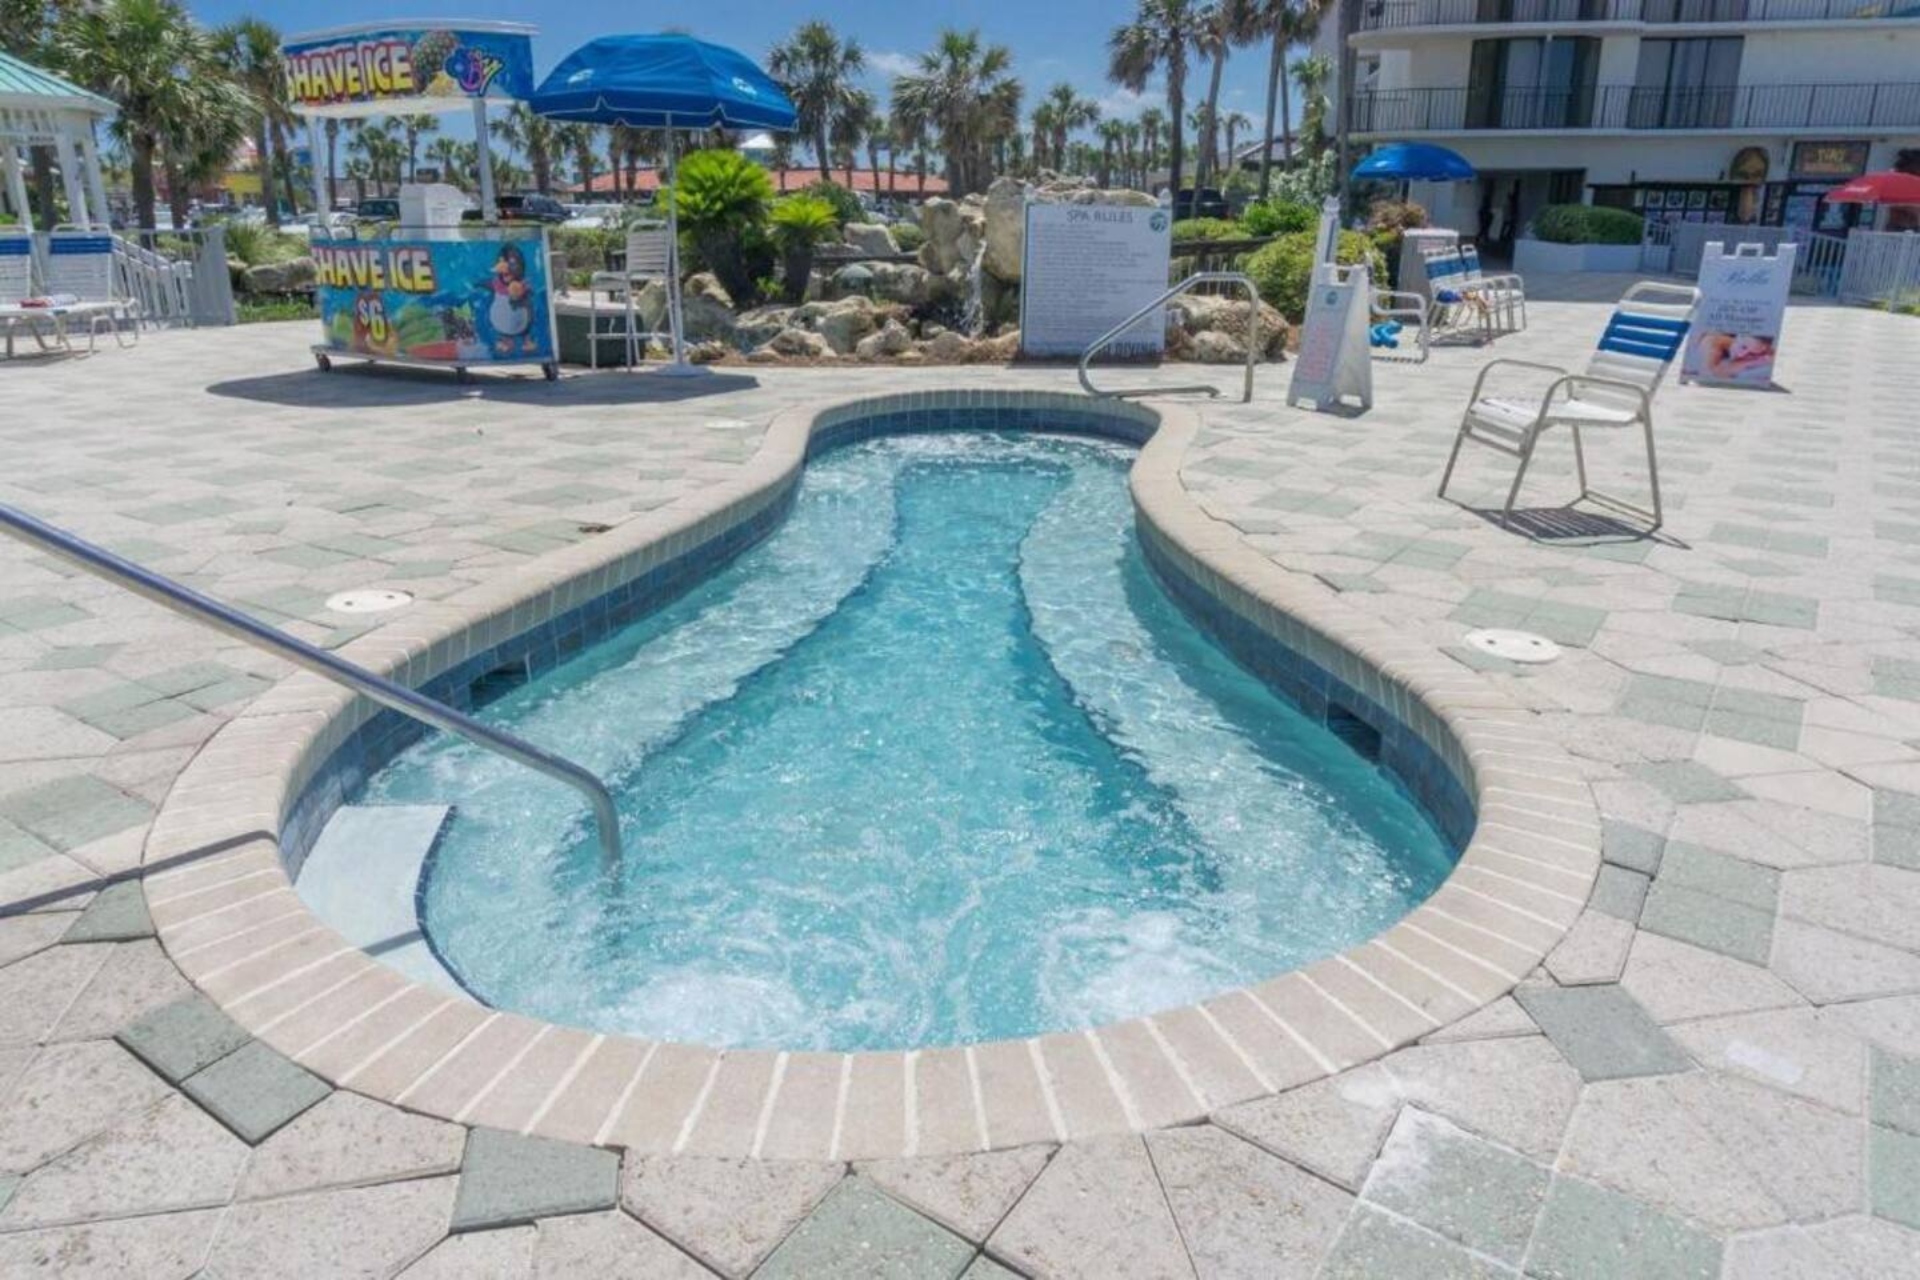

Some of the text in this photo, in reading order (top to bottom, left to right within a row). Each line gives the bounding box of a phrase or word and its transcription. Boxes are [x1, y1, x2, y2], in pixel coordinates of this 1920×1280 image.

[284, 50, 361, 102] SHAVE
[362, 44, 414, 93] ICE
[1066, 208, 1133, 225] SPA RULES
[311, 247, 436, 292] SHAVE ICE
[357, 297, 387, 342] $6
